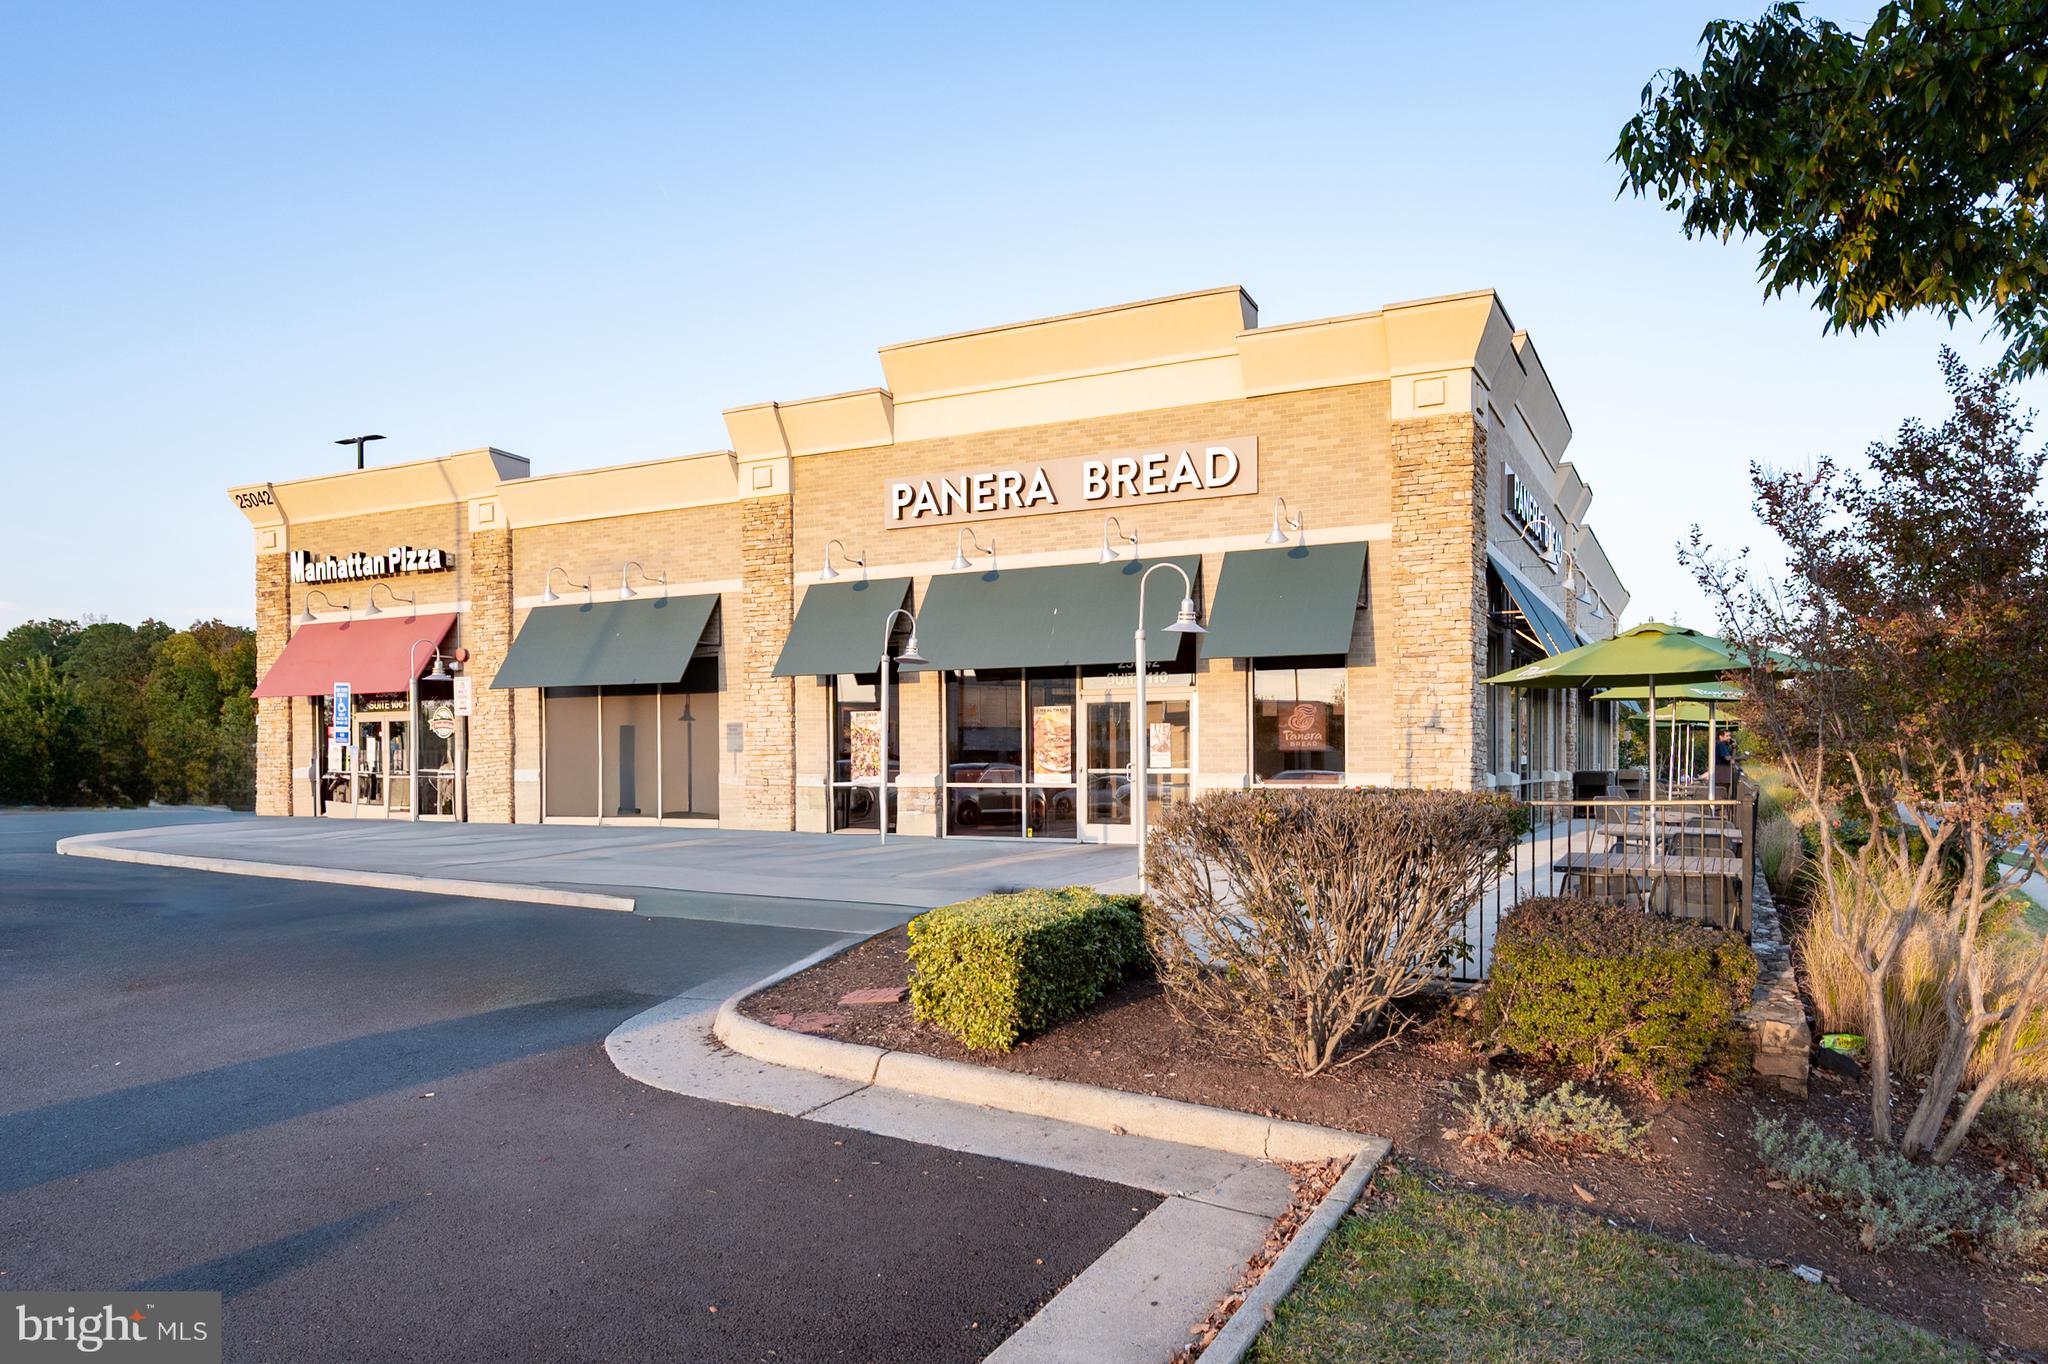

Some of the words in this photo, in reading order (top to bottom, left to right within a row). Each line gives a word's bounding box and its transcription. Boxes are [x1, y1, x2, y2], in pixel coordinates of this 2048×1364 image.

[892, 466, 1058, 520] PANERA
[1083, 446, 1240, 502] BREAD
[235, 490, 274, 509] 25042
[1514, 472, 1542, 542] PANERA
[1544, 515, 1563, 563] BEAD
[290, 549, 388, 584] Manhattan
[1106, 672, 1139, 685] SUIT
[369, 700, 390, 710] SUITE
[1282, 730, 1322, 741] Panera
